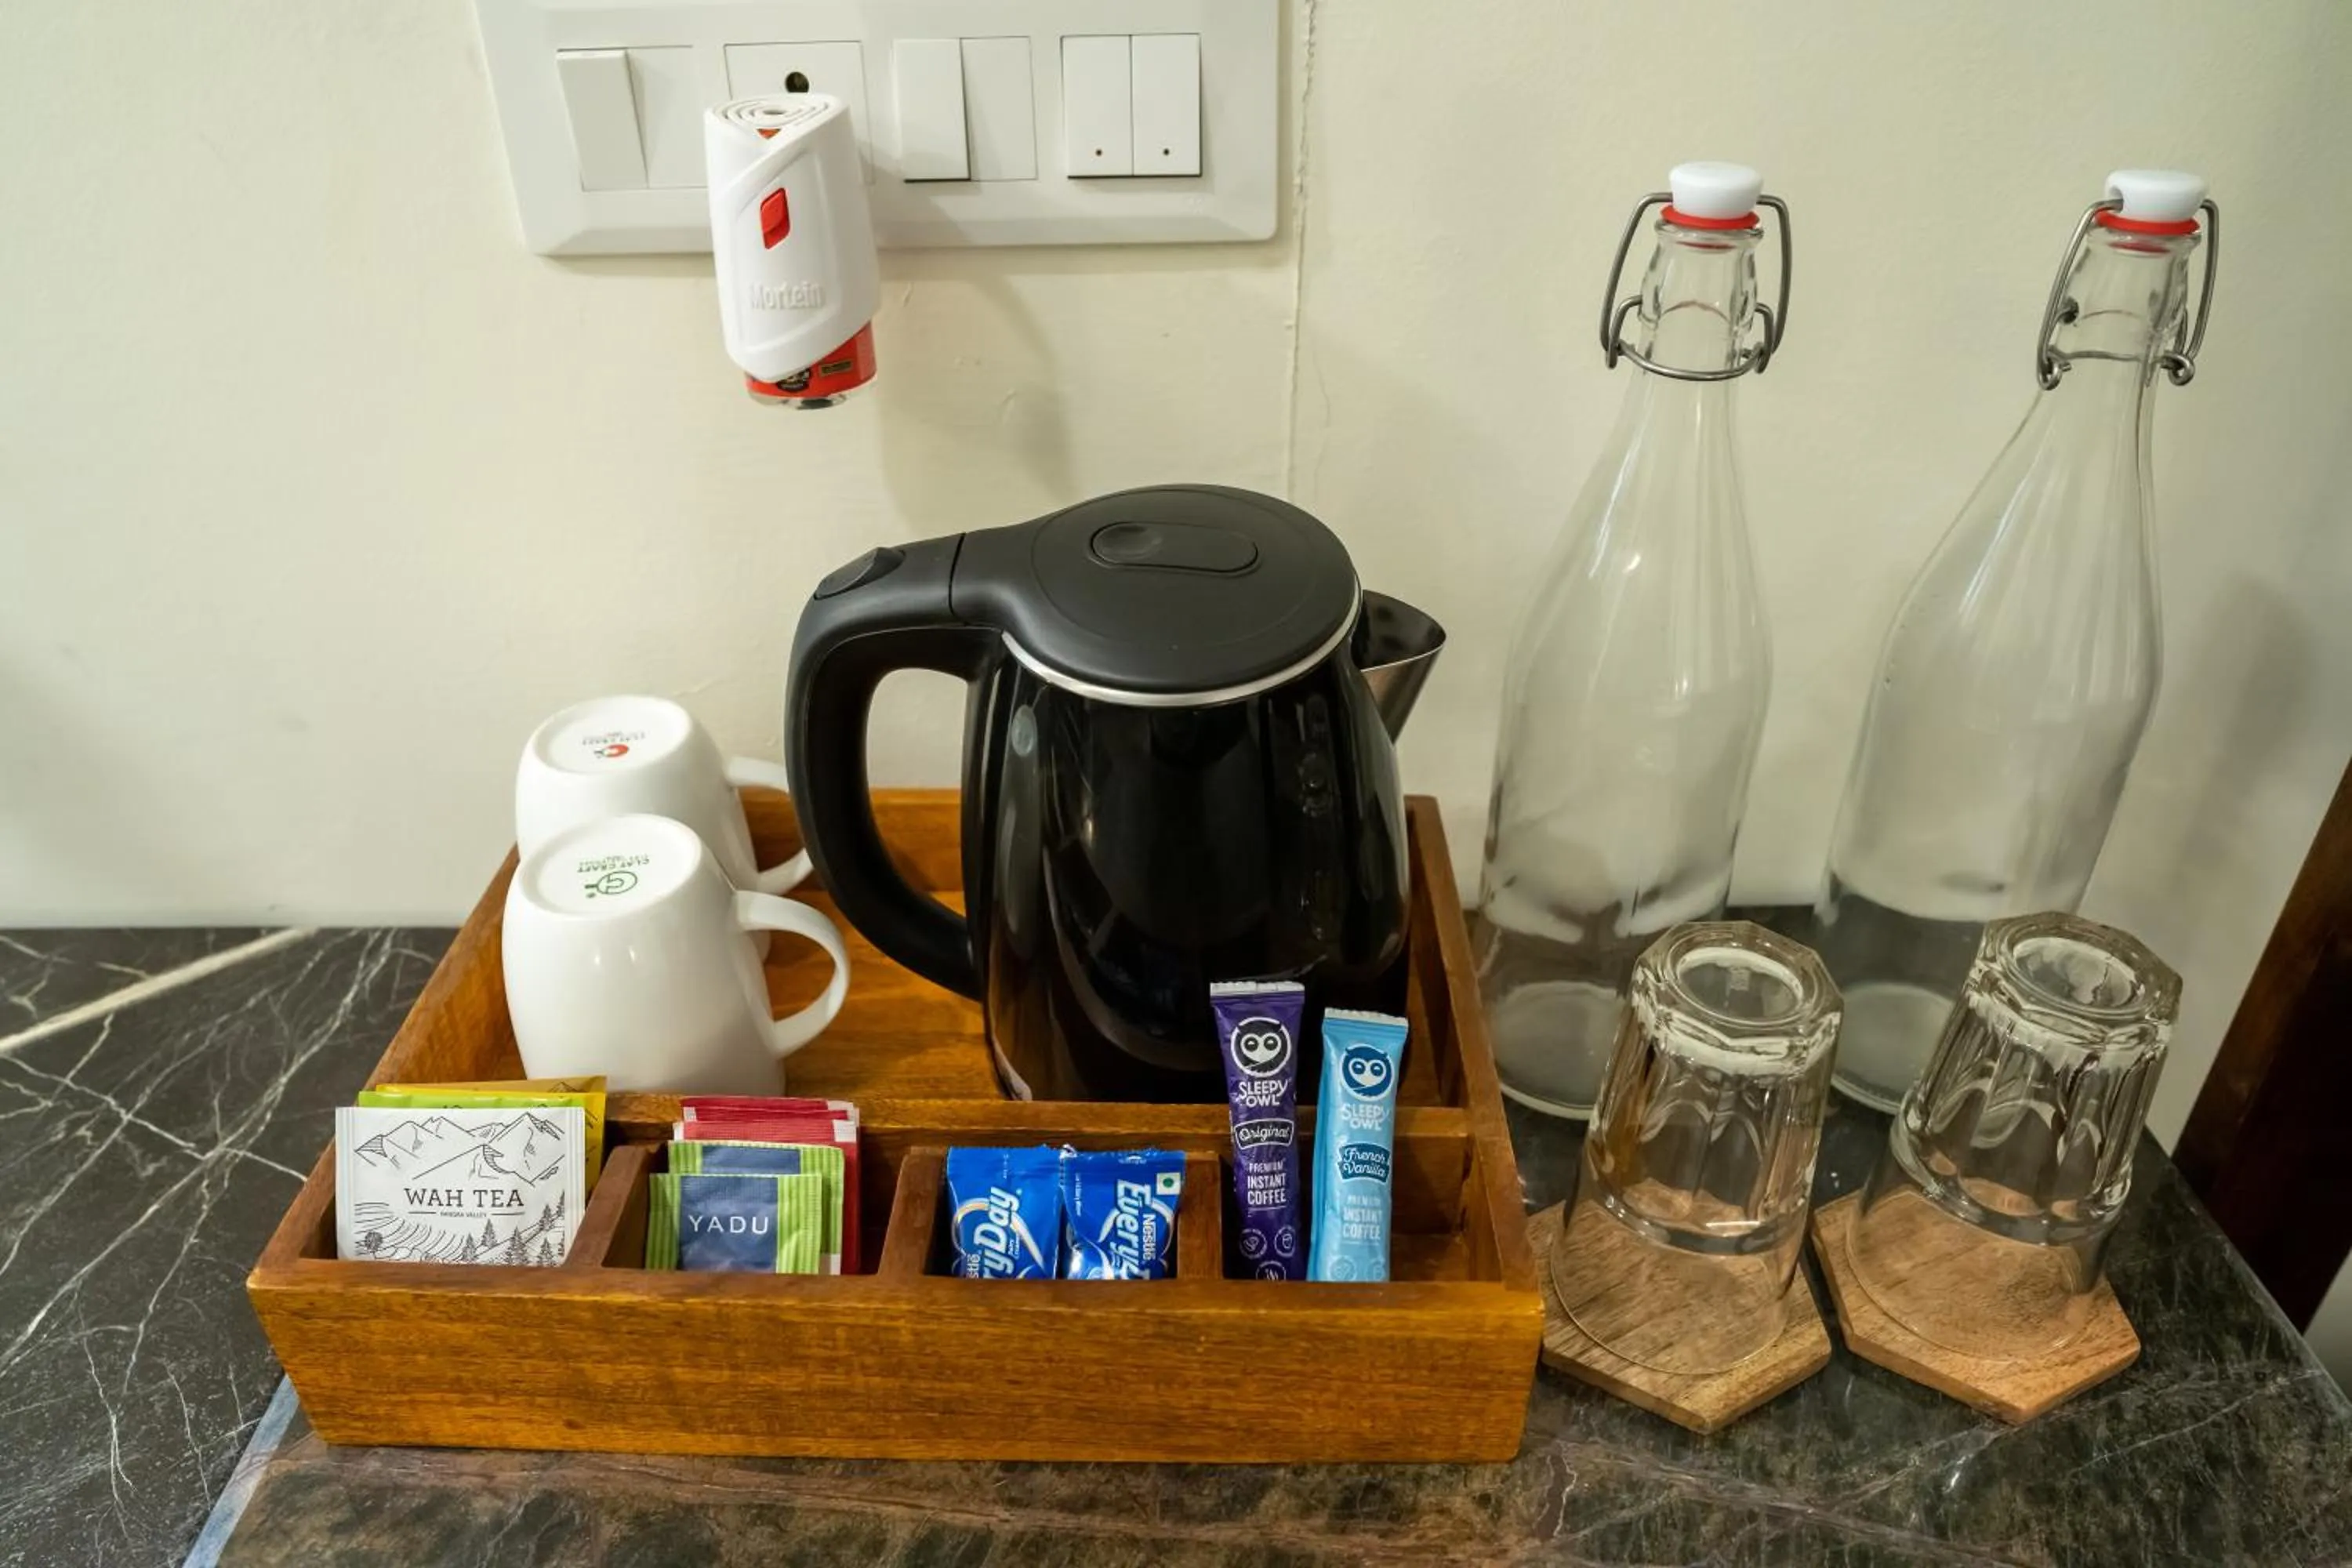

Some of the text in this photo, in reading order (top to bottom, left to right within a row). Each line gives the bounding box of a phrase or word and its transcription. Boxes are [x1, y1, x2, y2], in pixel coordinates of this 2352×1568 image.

[750, 281, 825, 310] Mortein
[1239, 1080, 1288, 1098] SLEEPY
[1246, 1096, 1280, 1108] OWL
[1341, 1103, 1389, 1122] SLEEPY
[1349, 1118, 1382, 1131] OWL
[1239, 1125, 1290, 1142] Original
[1344, 1147, 1385, 1163] French
[1343, 1161, 1385, 1177] Vanilla
[1247, 1174, 1287, 1189] INSTANT
[404, 1188, 524, 1207] WAH TEA
[1247, 1189, 1287, 1205] COFFEE
[688, 1214, 769, 1235] YADU
[1343, 1222, 1381, 1240] COFFEE
